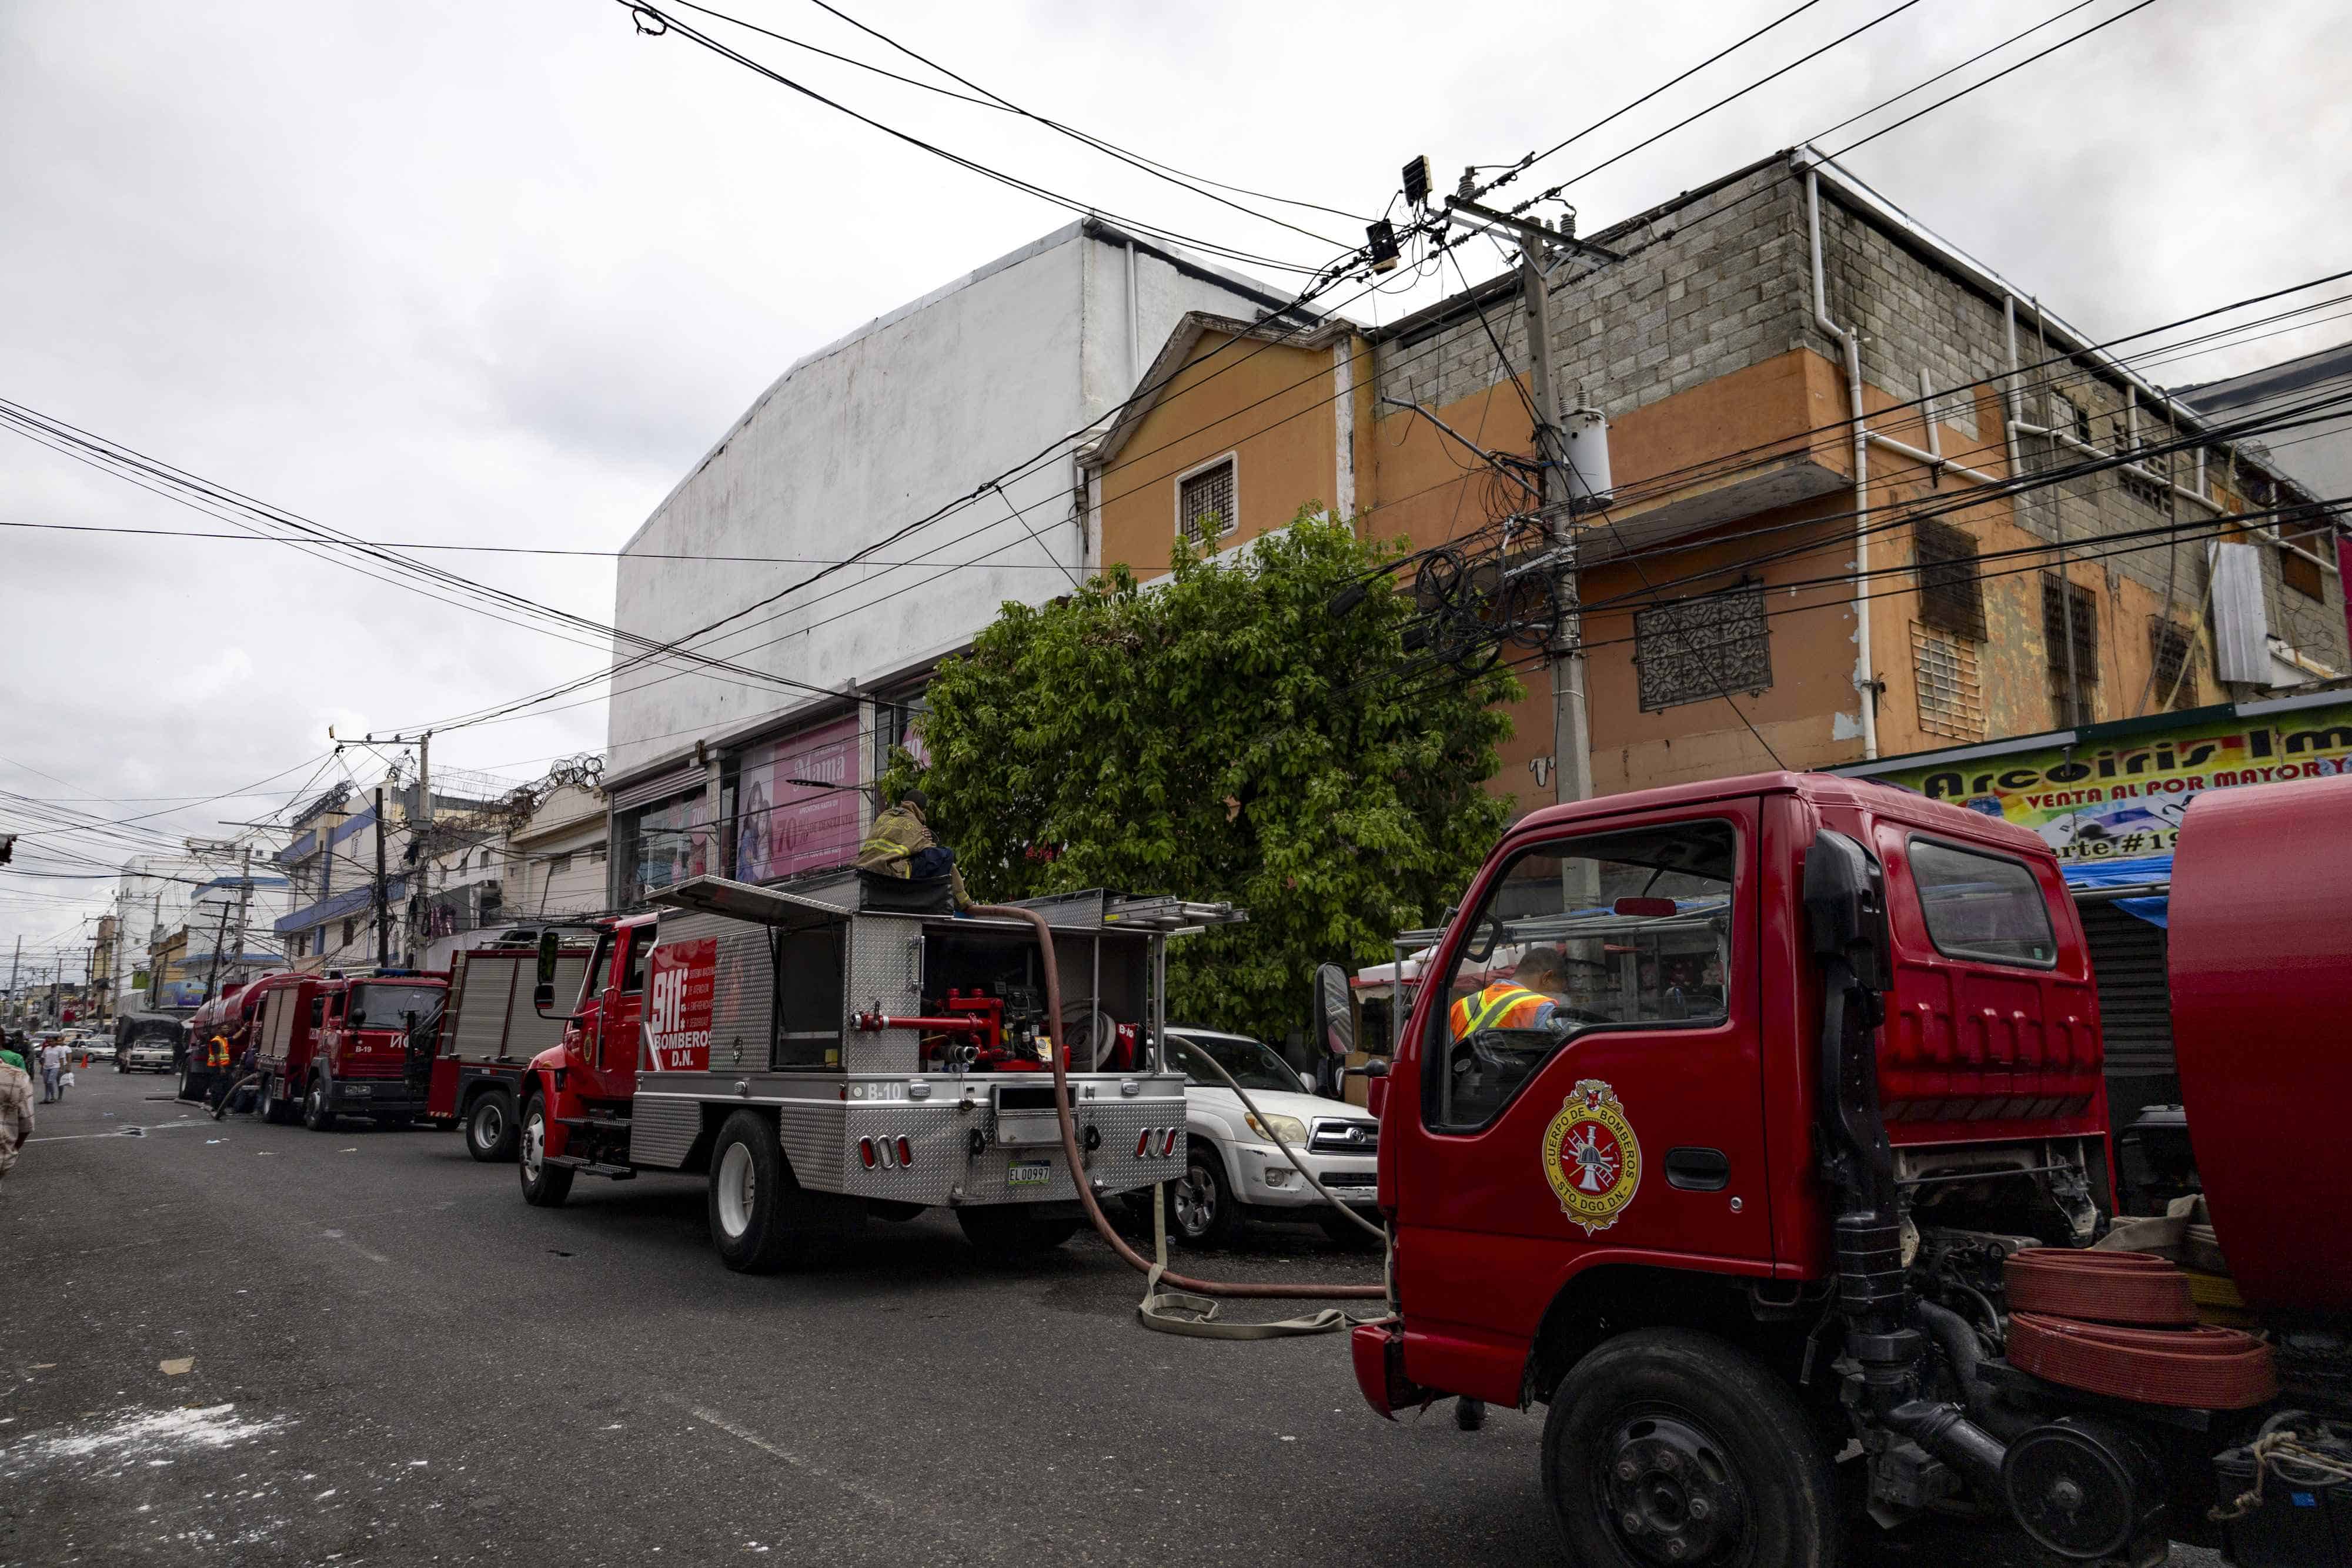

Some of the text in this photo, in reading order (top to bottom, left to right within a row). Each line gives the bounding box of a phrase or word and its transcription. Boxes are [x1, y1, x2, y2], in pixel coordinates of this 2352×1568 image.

[1924, 741, 2216, 798] Arcoiris
[2026, 757, 2348, 809] VENTA AL POR MAYOR Y
[652, 968, 683, 1034] 911
[671, 1049, 693, 1066] D.N.
[867, 1082, 901, 1101] B-10
[1548, 1107, 1636, 1179] CUERPO DE BOMBEROS
[1557, 1181, 1626, 1211] STO. DGO. D.N.
